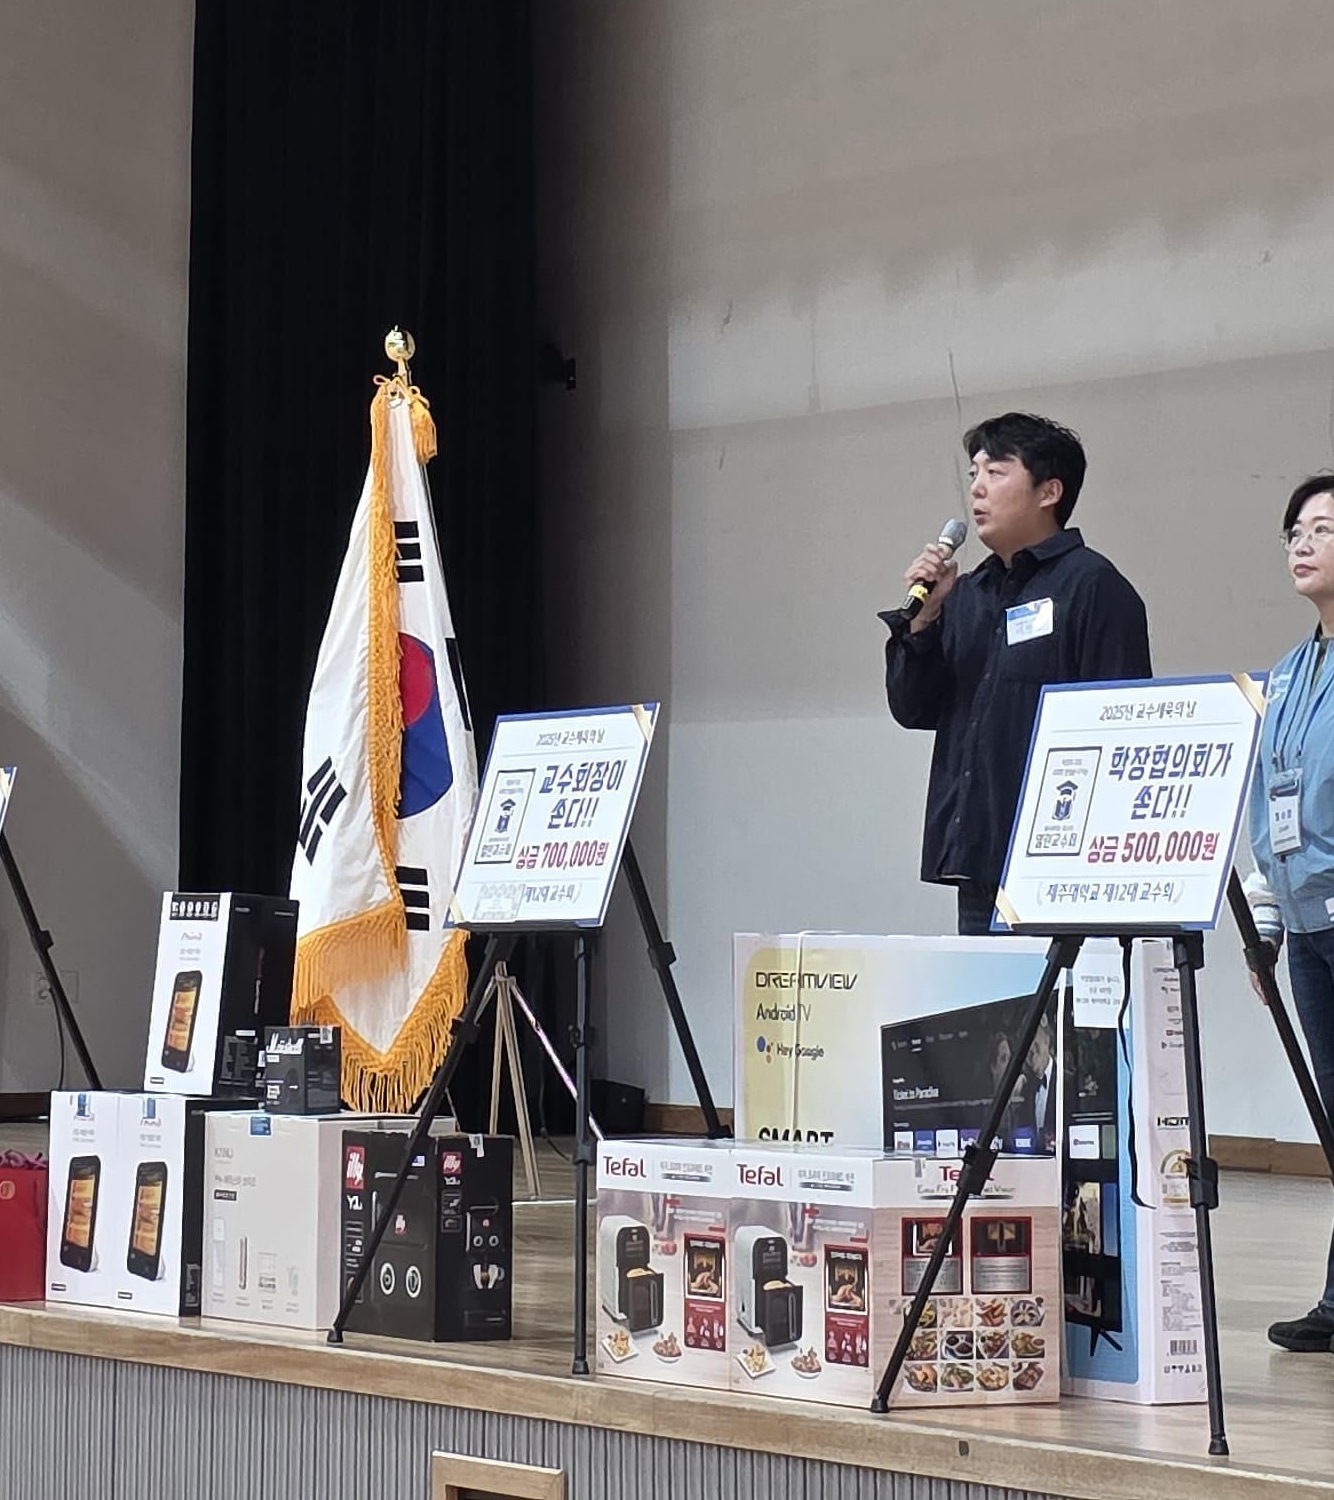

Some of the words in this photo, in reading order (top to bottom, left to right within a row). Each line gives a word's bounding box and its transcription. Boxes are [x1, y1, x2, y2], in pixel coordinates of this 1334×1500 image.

[539, 759, 628, 794] 교수회장이
[1108, 742, 1234, 781] 학장협의회가
[547, 796, 600, 830] 쏜다!!
[1130, 784, 1193, 820] 쏜다!!
[516, 845, 540, 870] 상금
[540, 840, 609, 871] 700,000원
[1087, 835, 1119, 864] 상금
[1121, 830, 1220, 865] 500,000원
[755, 971, 858, 990] DREAMVIEW
[756, 1002, 796, 1021] Android
[602, 1155, 647, 1179] Tefal
[736, 1163, 785, 1187] Tefal
